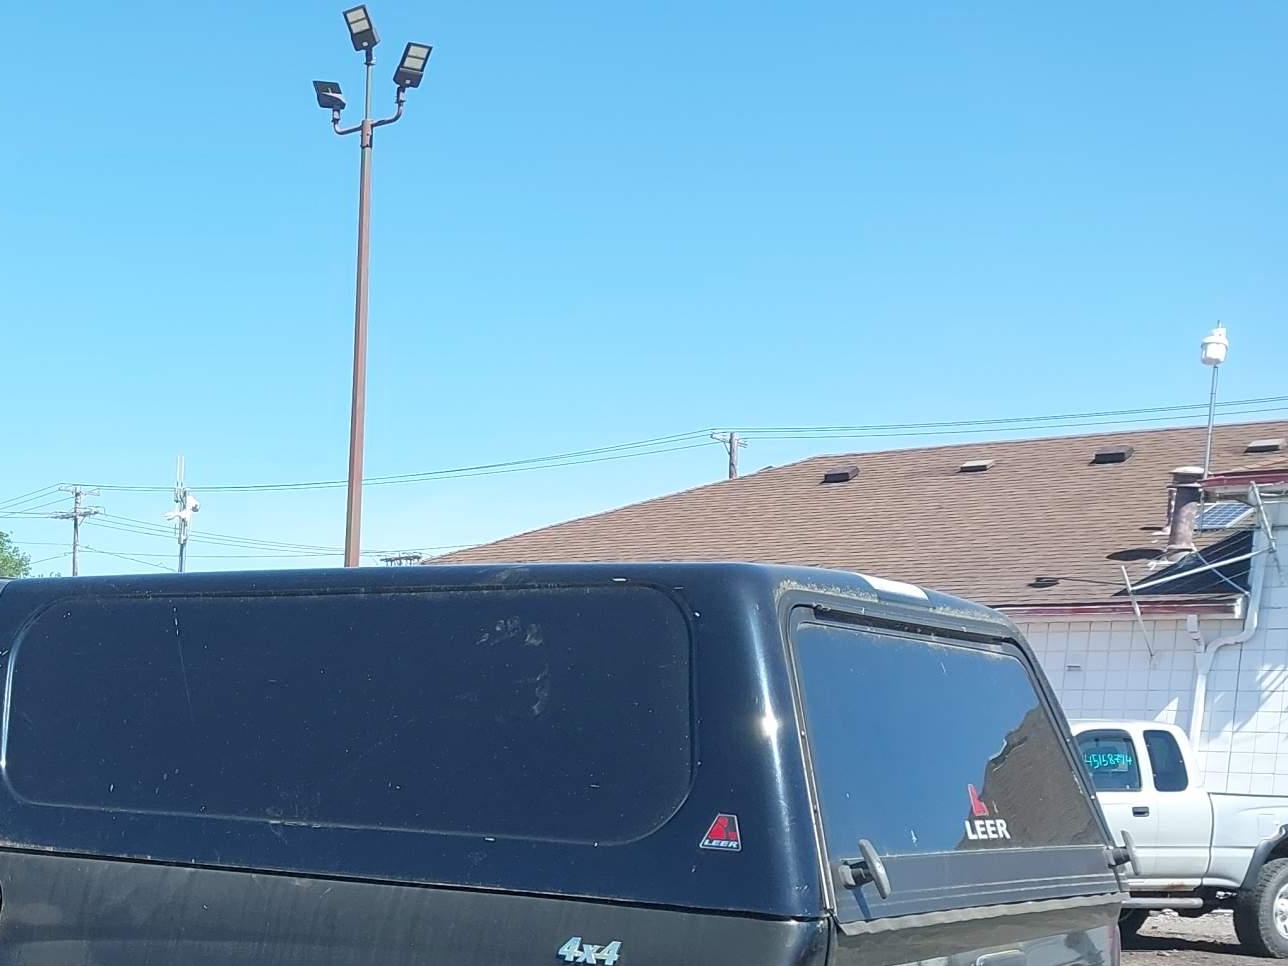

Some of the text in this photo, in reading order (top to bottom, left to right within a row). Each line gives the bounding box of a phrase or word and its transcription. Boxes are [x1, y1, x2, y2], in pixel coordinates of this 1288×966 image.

[964, 819, 1011, 840] LEER
[703, 839, 738, 848] LEER
[558, 936, 623, 966] 4x4
